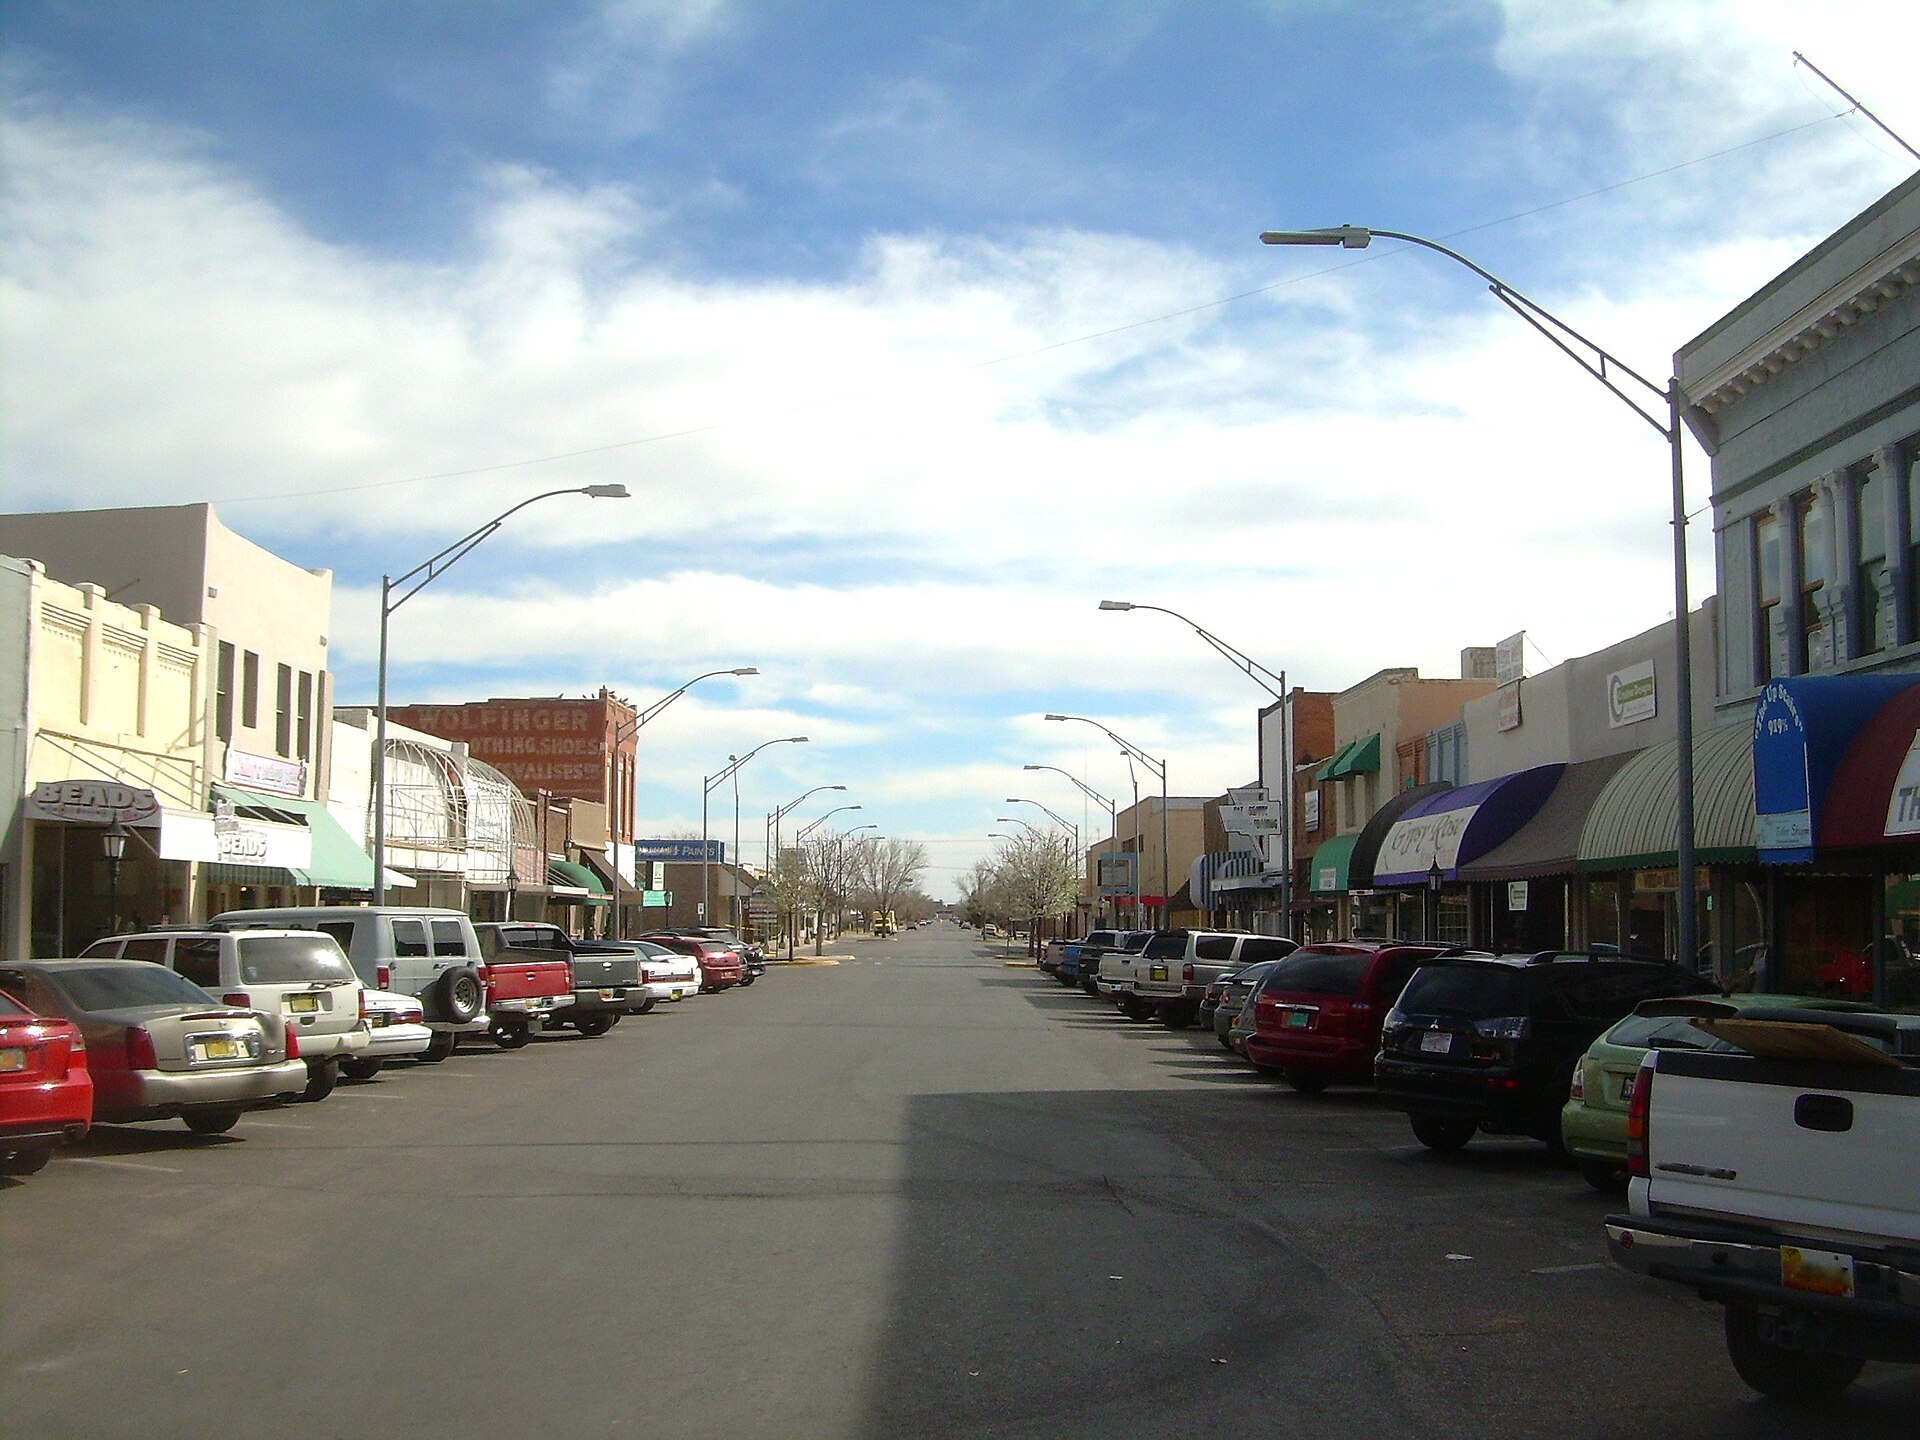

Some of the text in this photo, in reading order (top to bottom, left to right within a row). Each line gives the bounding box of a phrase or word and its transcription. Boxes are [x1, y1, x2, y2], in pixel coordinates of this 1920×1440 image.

[1766, 685, 1777, 703] Up
[418, 707, 589, 732] WOLFINGER
[36, 782, 154, 811] BEADS
[222, 836, 267, 857] BEADS
